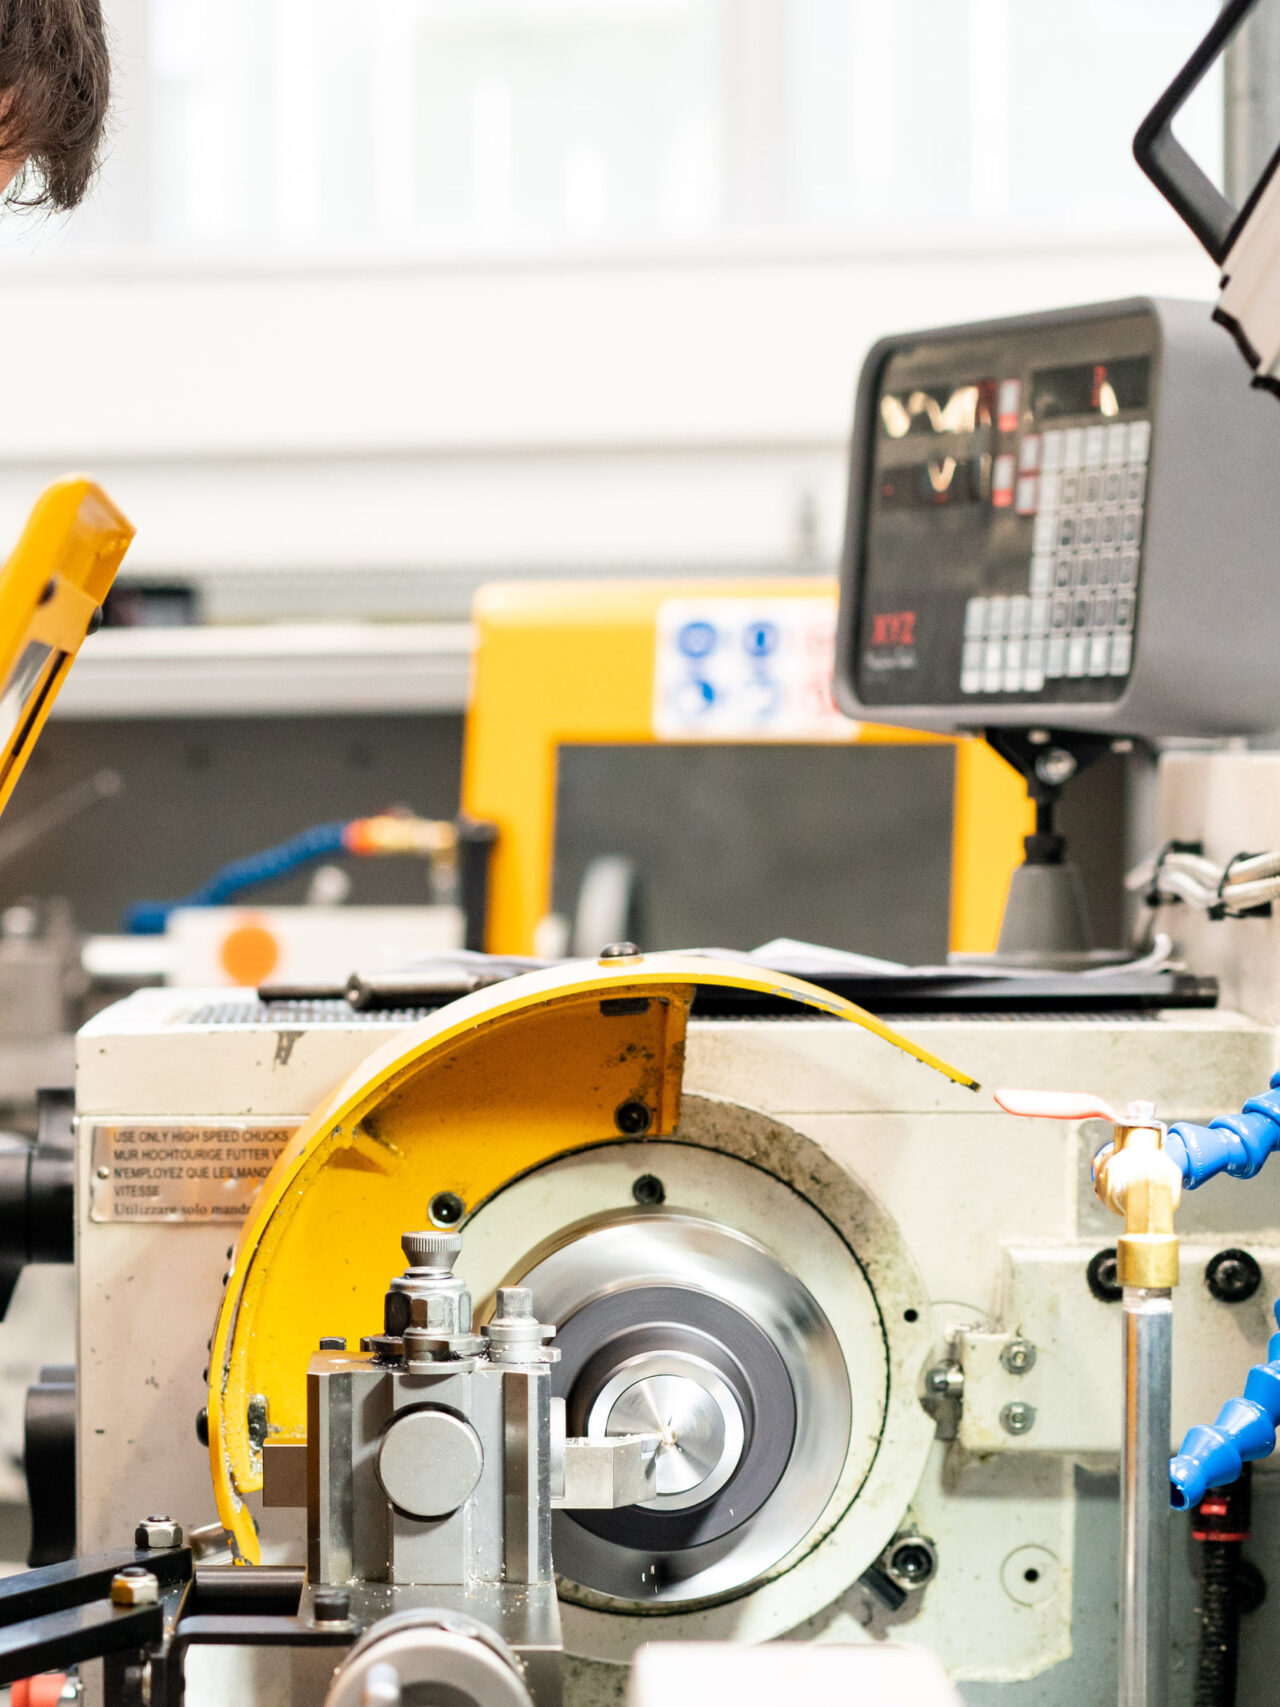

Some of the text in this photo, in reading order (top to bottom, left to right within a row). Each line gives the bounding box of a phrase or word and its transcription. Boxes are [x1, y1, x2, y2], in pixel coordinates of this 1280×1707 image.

[113, 1130, 289, 1143] USE ONLY HIGH SPEED CHUCKS
[141, 1148, 223, 1161] HOCHTOURIGE
[226, 1148, 269, 1161] FUTTER
[113, 1167, 184, 1179] N'EMPLOYEZ
[186, 1167, 210, 1179] QUE
[113, 1185, 160, 1197] VITESSE
[114, 1203, 178, 1216] Utilizzare
[181, 1203, 208, 1216] solo
